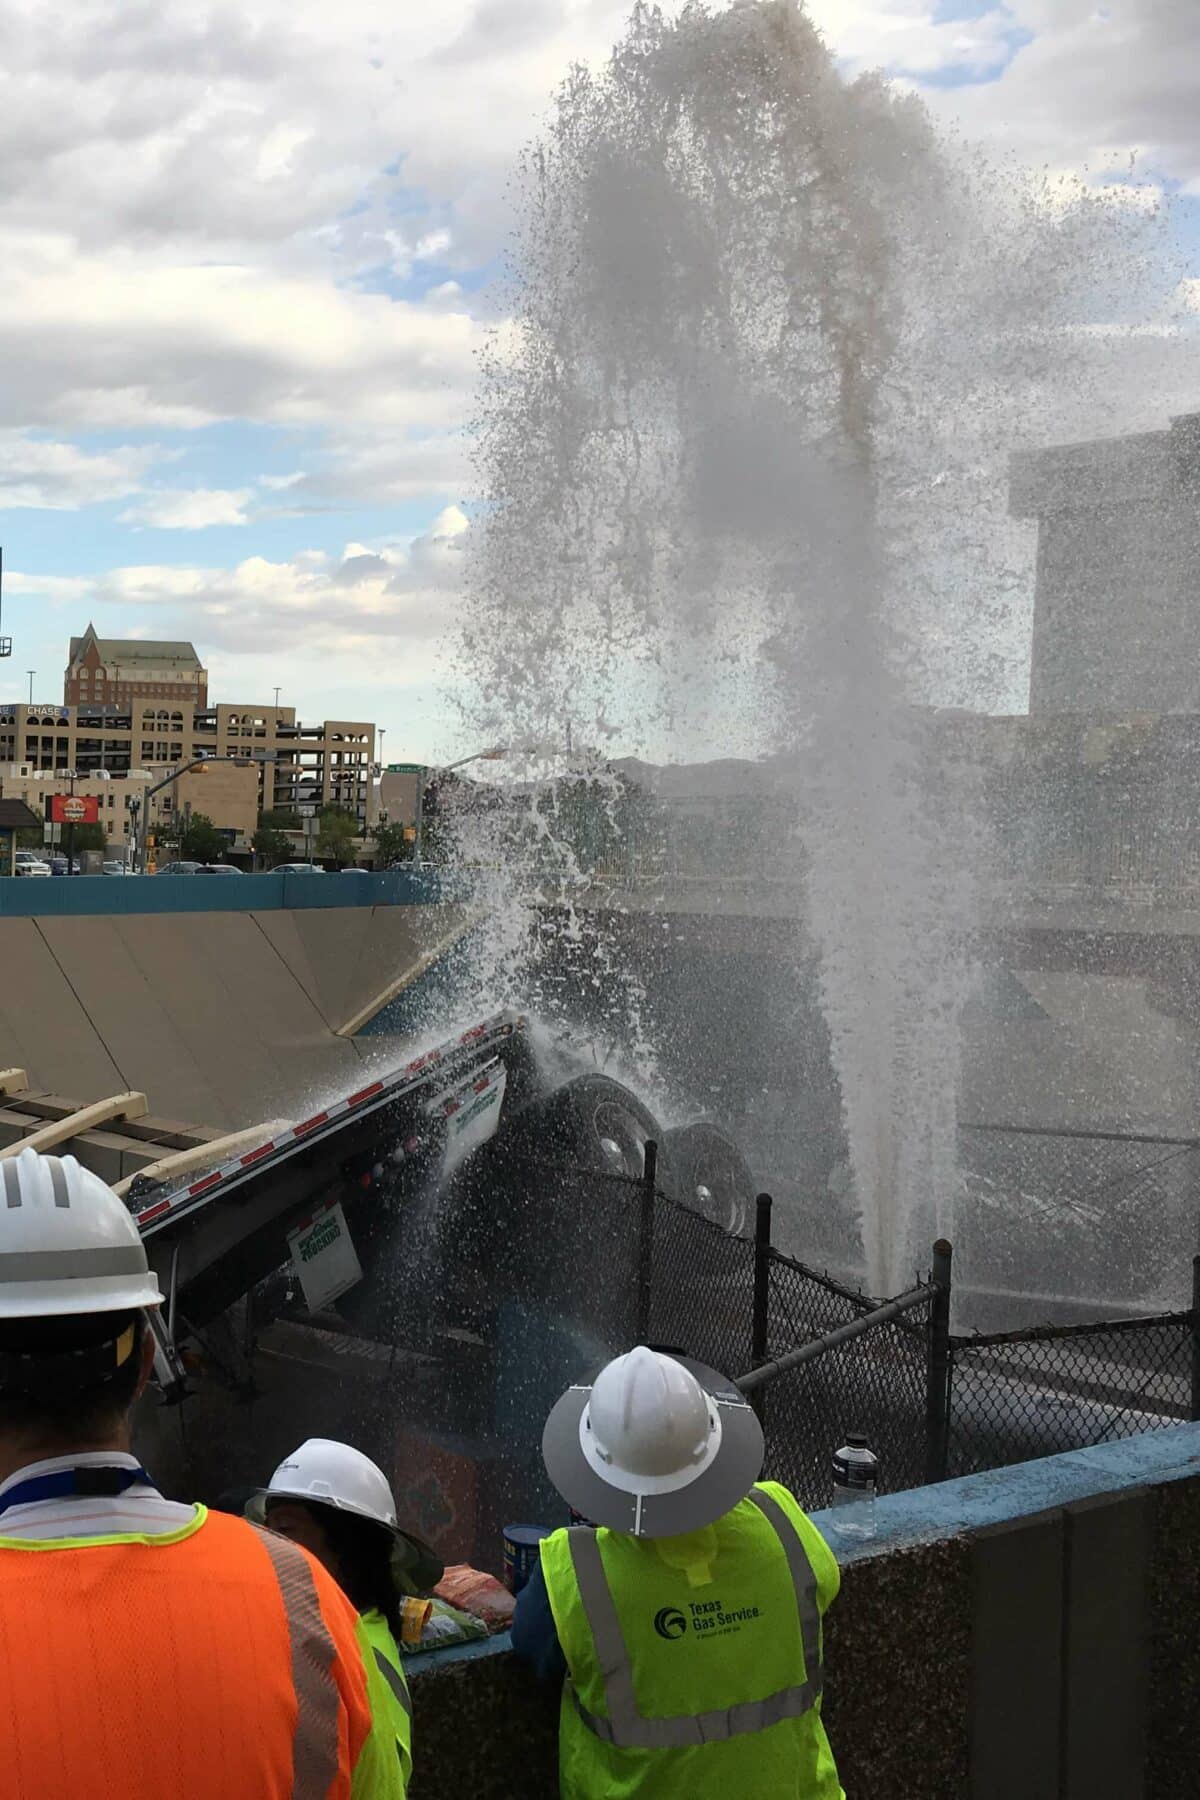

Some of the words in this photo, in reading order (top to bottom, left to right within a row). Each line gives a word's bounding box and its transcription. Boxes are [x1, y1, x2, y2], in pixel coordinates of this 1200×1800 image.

[28, 706, 60, 717] CHASE
[688, 1601, 722, 1616] Texas
[693, 1617, 715, 1631] Gas
[717, 1607, 759, 1626] Service
